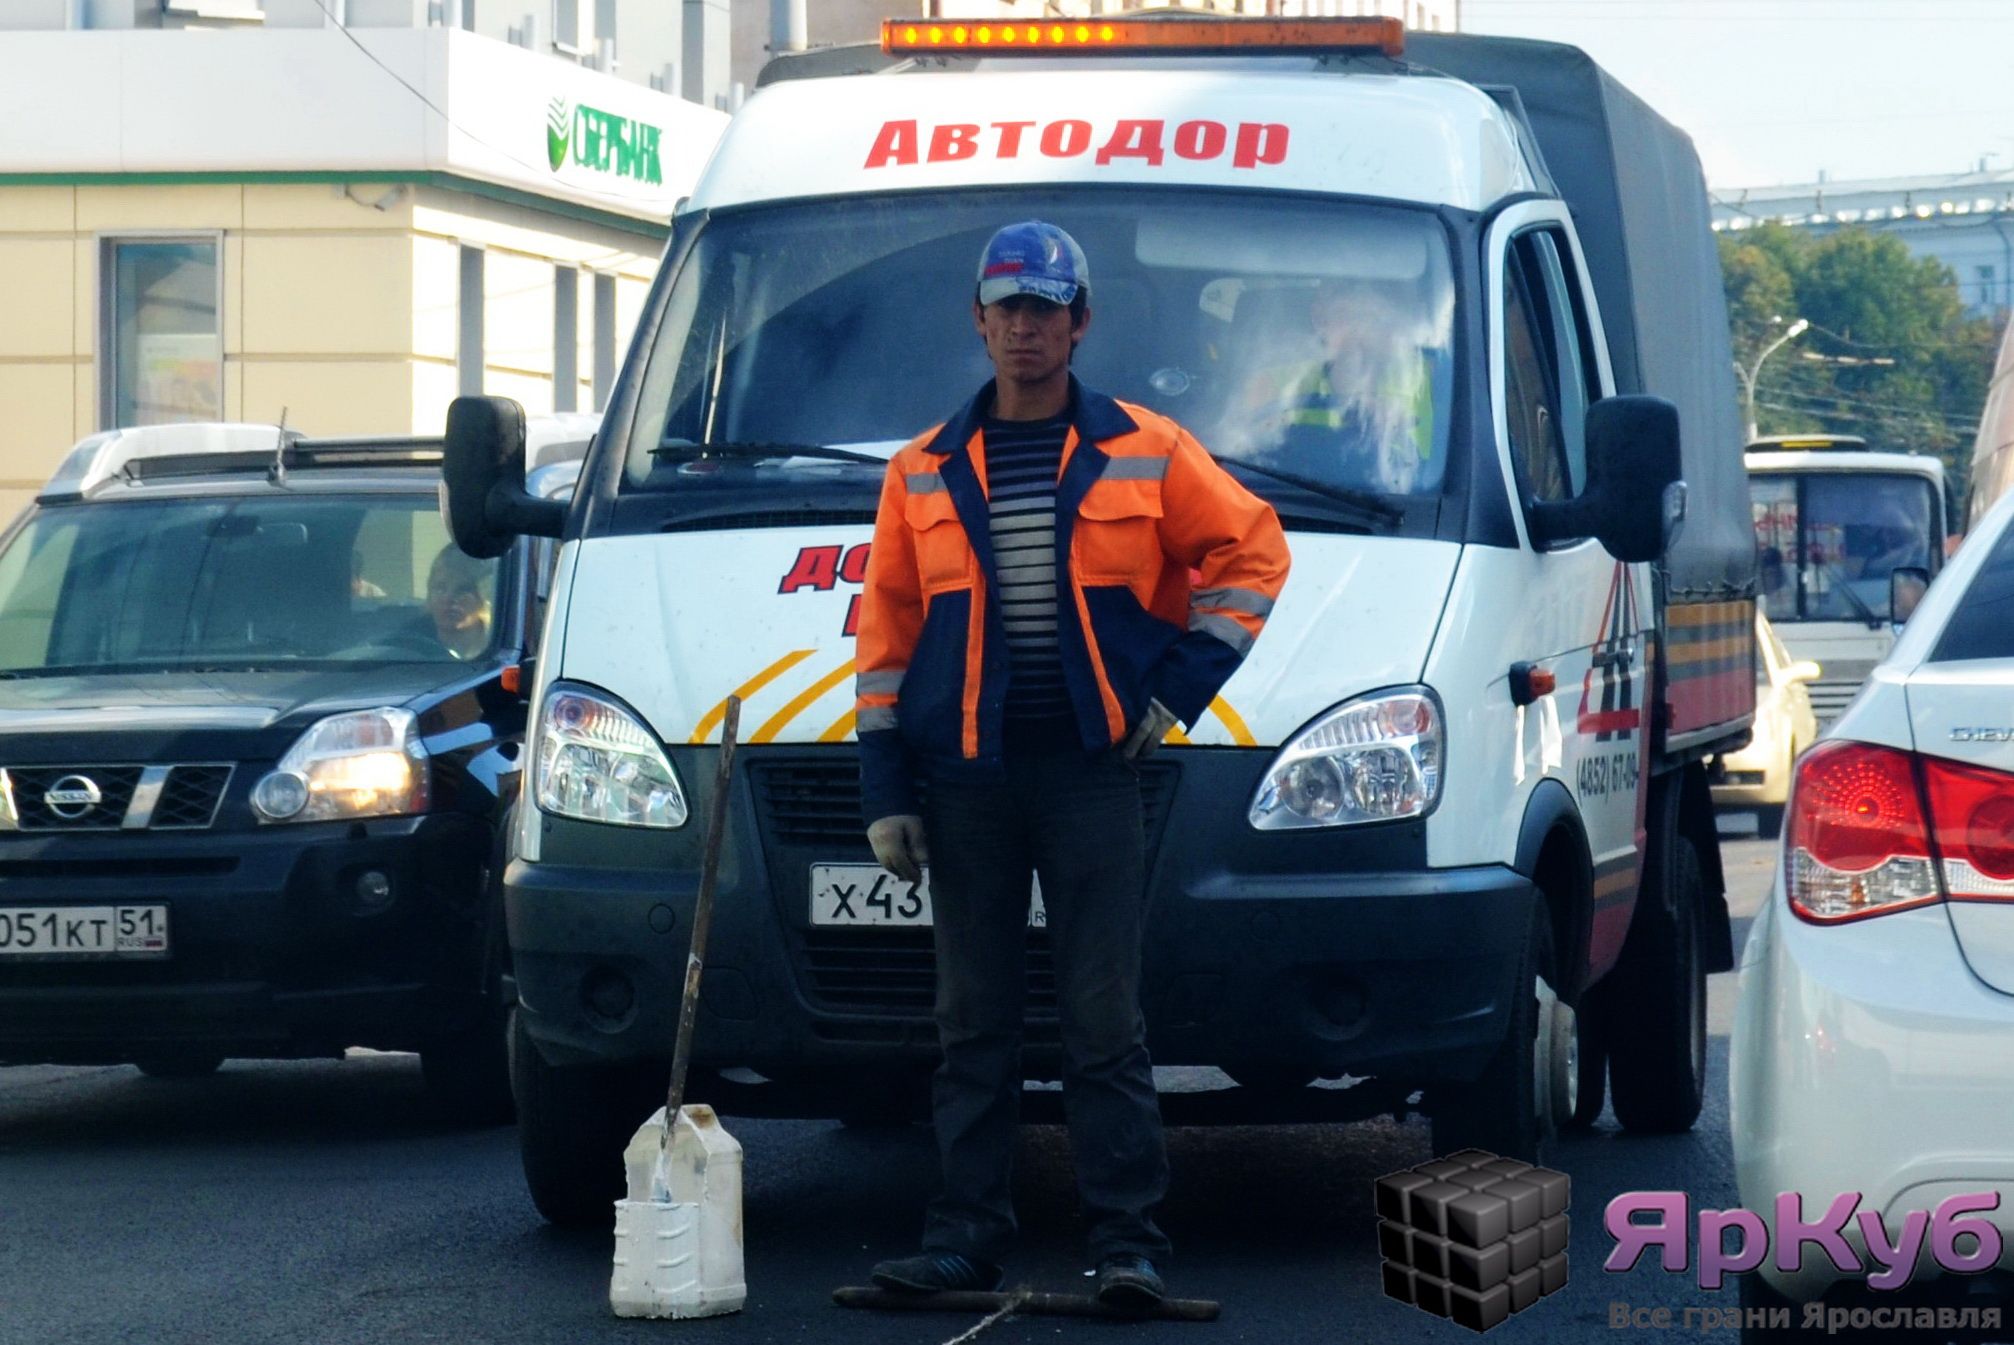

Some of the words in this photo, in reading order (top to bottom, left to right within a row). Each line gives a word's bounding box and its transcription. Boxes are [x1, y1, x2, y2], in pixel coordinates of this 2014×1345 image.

[863, 119, 1290, 169] Автодор
[1576, 755, 1609, 808] (4852)
[118, 937, 144, 948] RUS
[119, 909, 154, 937] 51
